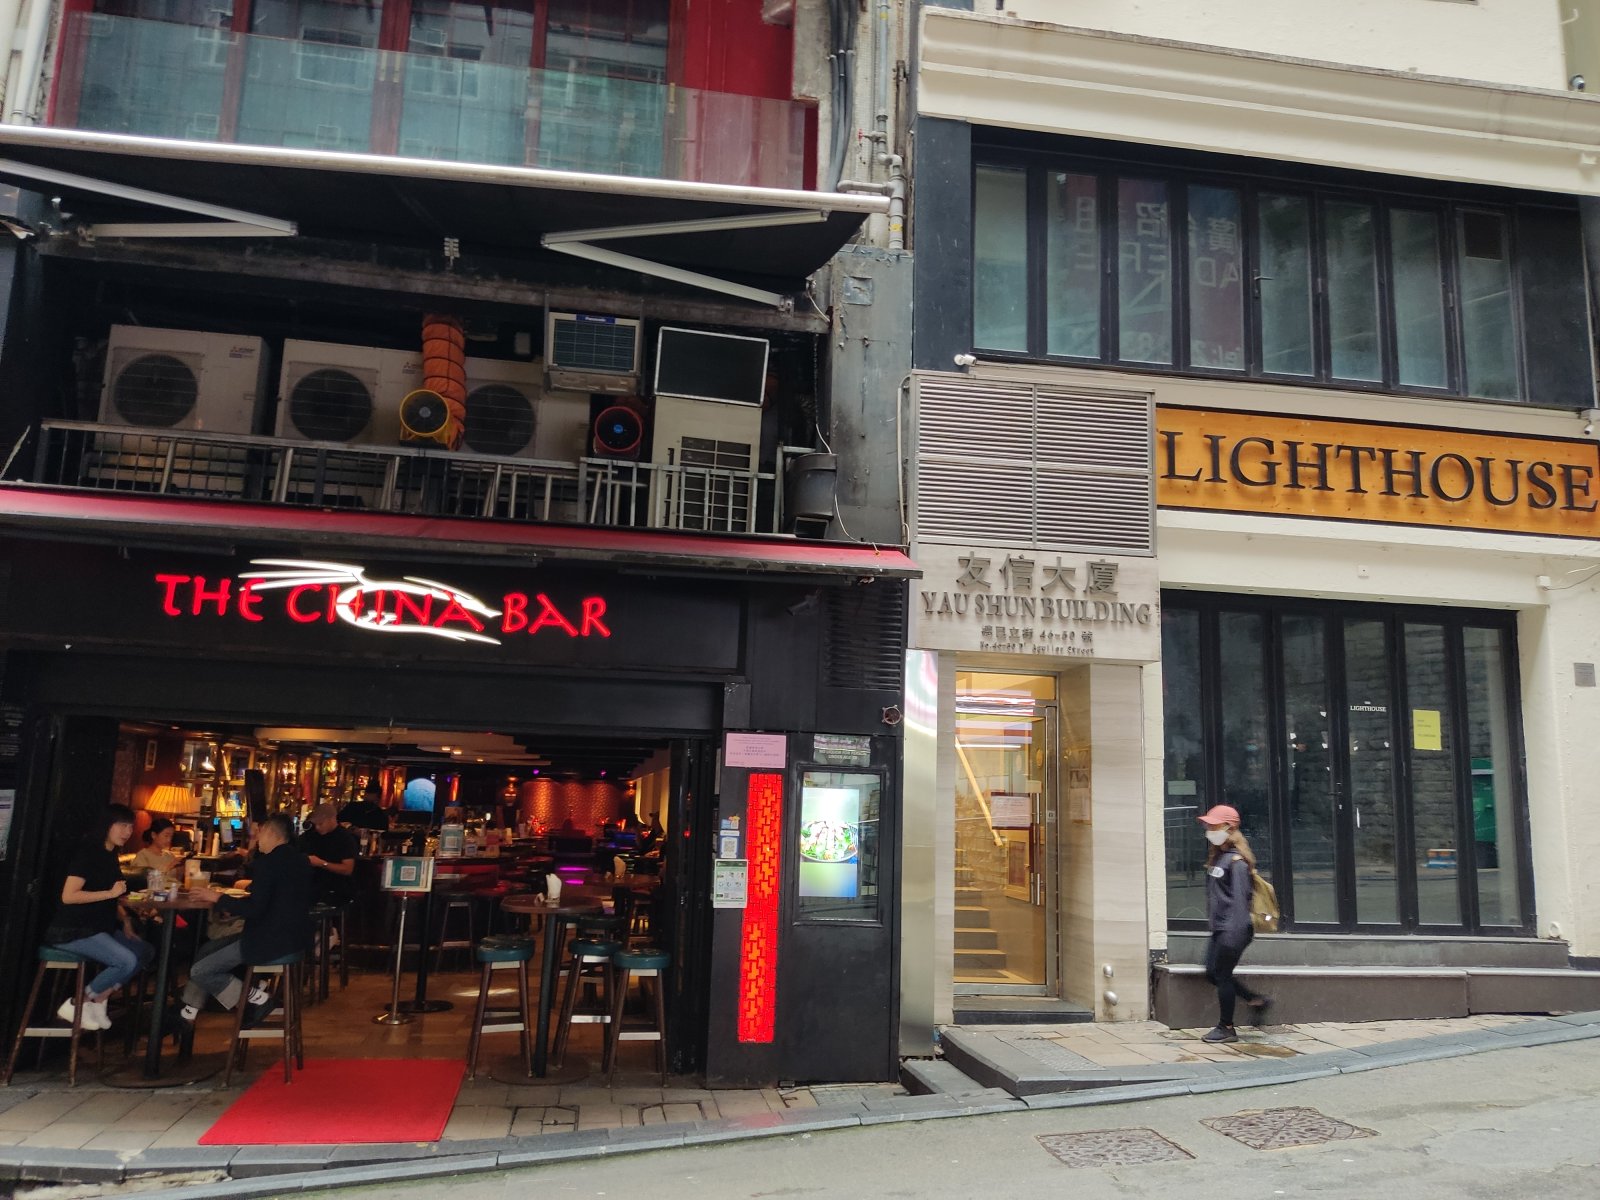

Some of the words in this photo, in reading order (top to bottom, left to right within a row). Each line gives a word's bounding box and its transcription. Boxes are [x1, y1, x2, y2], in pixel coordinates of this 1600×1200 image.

[1160, 430, 1599, 513] LIGHTHOUSE
[956, 551, 1119, 596] 友信大廈
[156, 573, 266, 622] THE
[286, 583, 485, 632] CHINA
[502, 593, 611, 637] BAR
[921, 591, 969, 615] YAU
[975, 593, 1036, 618] SHUN
[1040, 598, 1152, 625] BUILDING
[1067, 646, 1095, 655] Street
[1350, 705, 1387, 713] LIGHTHOUSE
